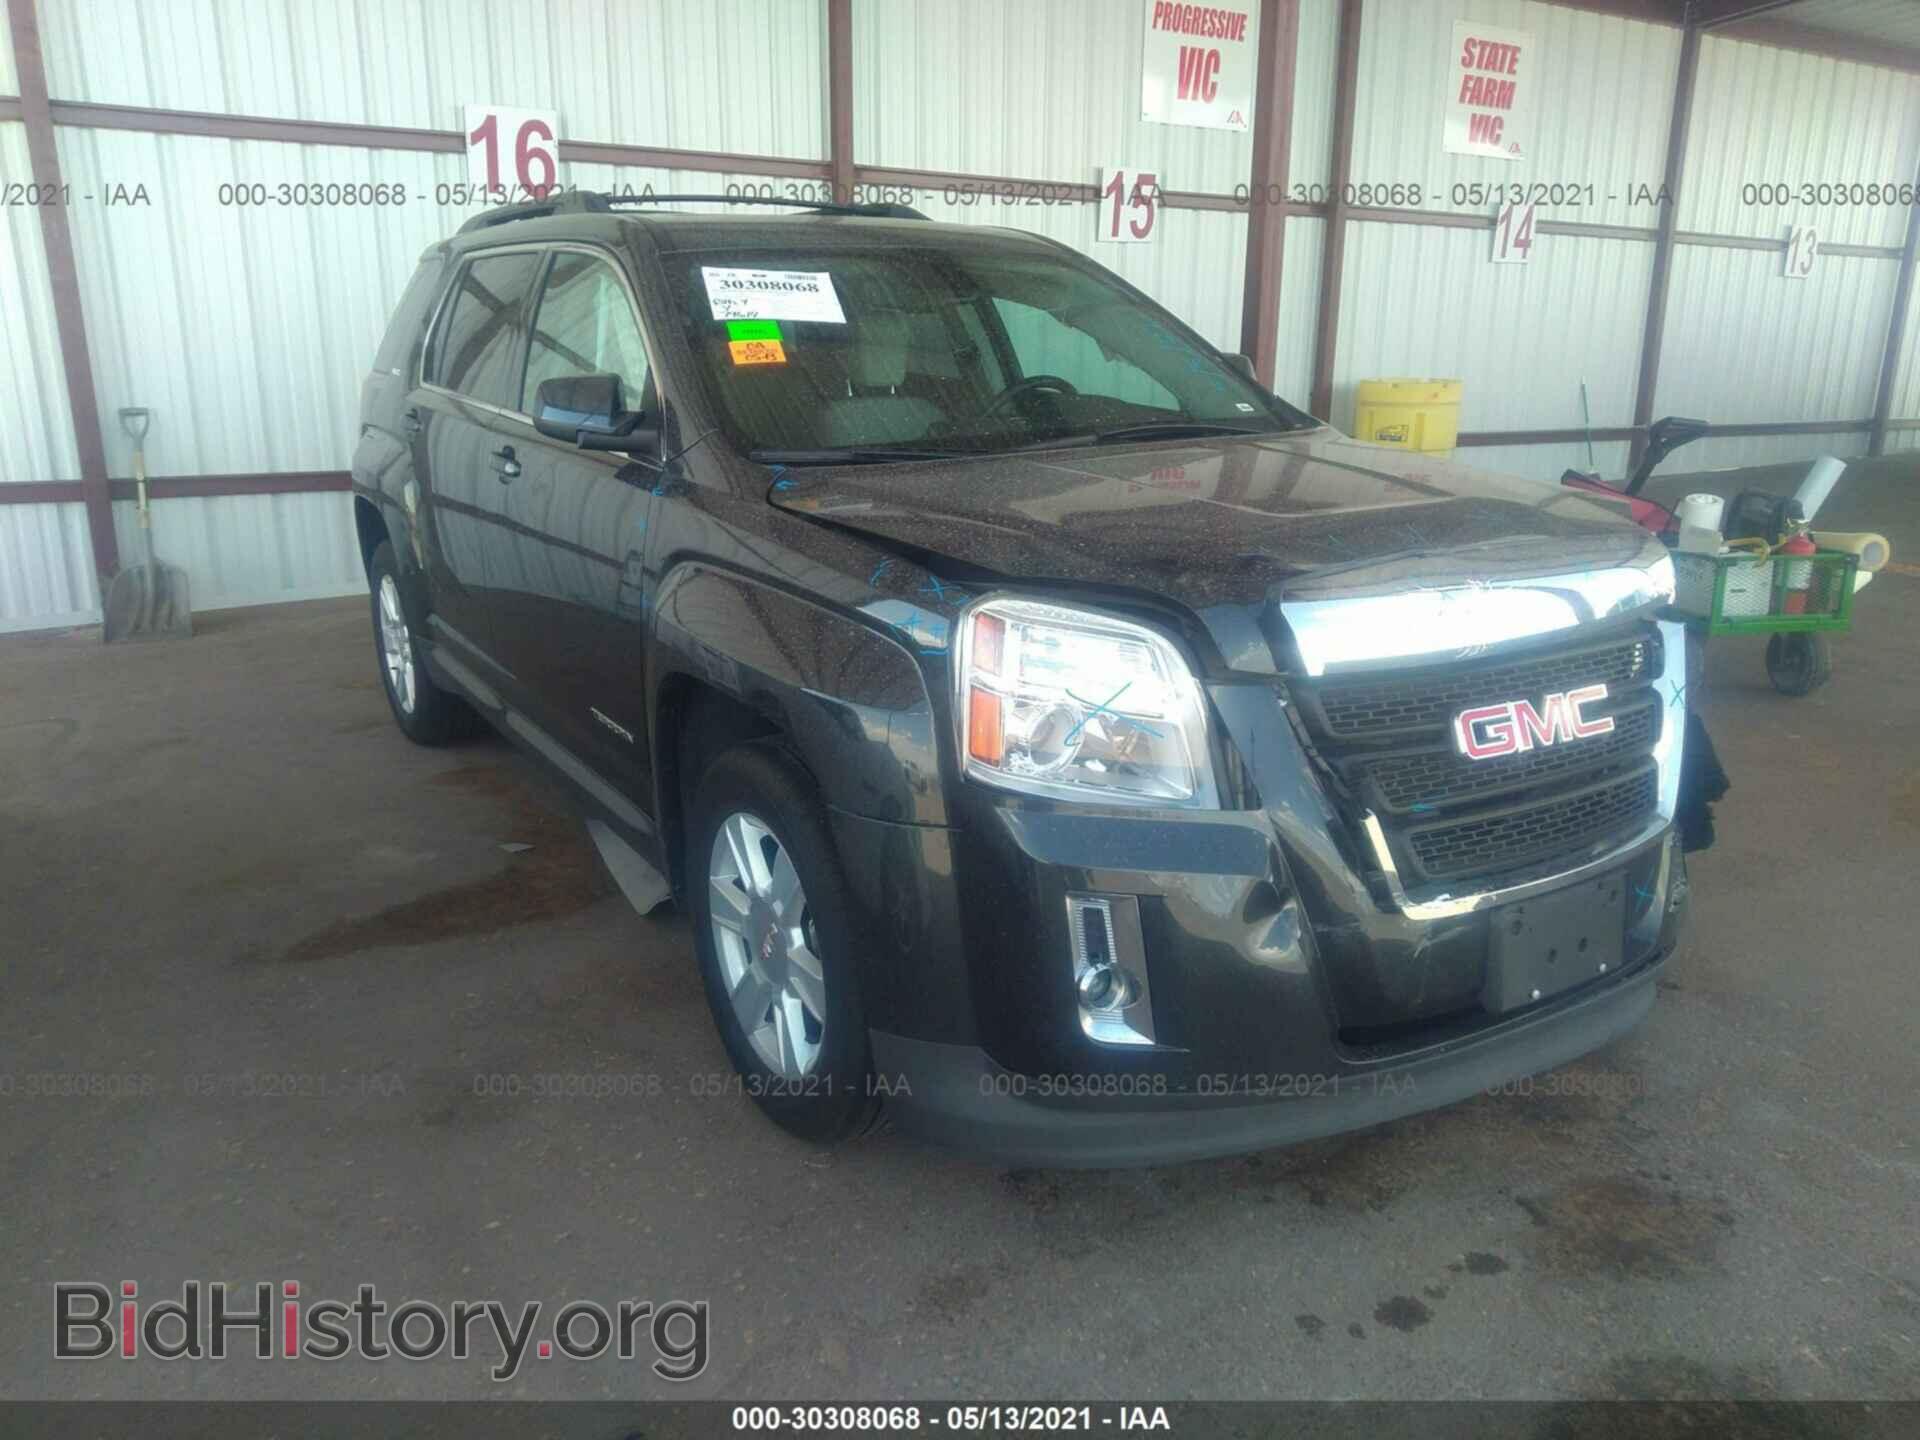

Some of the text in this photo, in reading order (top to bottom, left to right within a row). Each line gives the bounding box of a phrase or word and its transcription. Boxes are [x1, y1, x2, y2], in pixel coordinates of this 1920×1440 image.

[1152, 0, 1247, 42] PROGRESSIVE
[1177, 46, 1220, 104] VIC
[1461, 37, 1521, 75] STATE
[1459, 74, 1516, 110] FARM
[1468, 113, 1504, 146] VIC
[470, 114, 555, 198] 16
[1106, 171, 1156, 239] 15
[1500, 204, 1534, 259] 14
[1791, 228, 1816, 275] 13
[720, 280, 819, 292] 30308068
[1455, 684, 1615, 760] GMC
